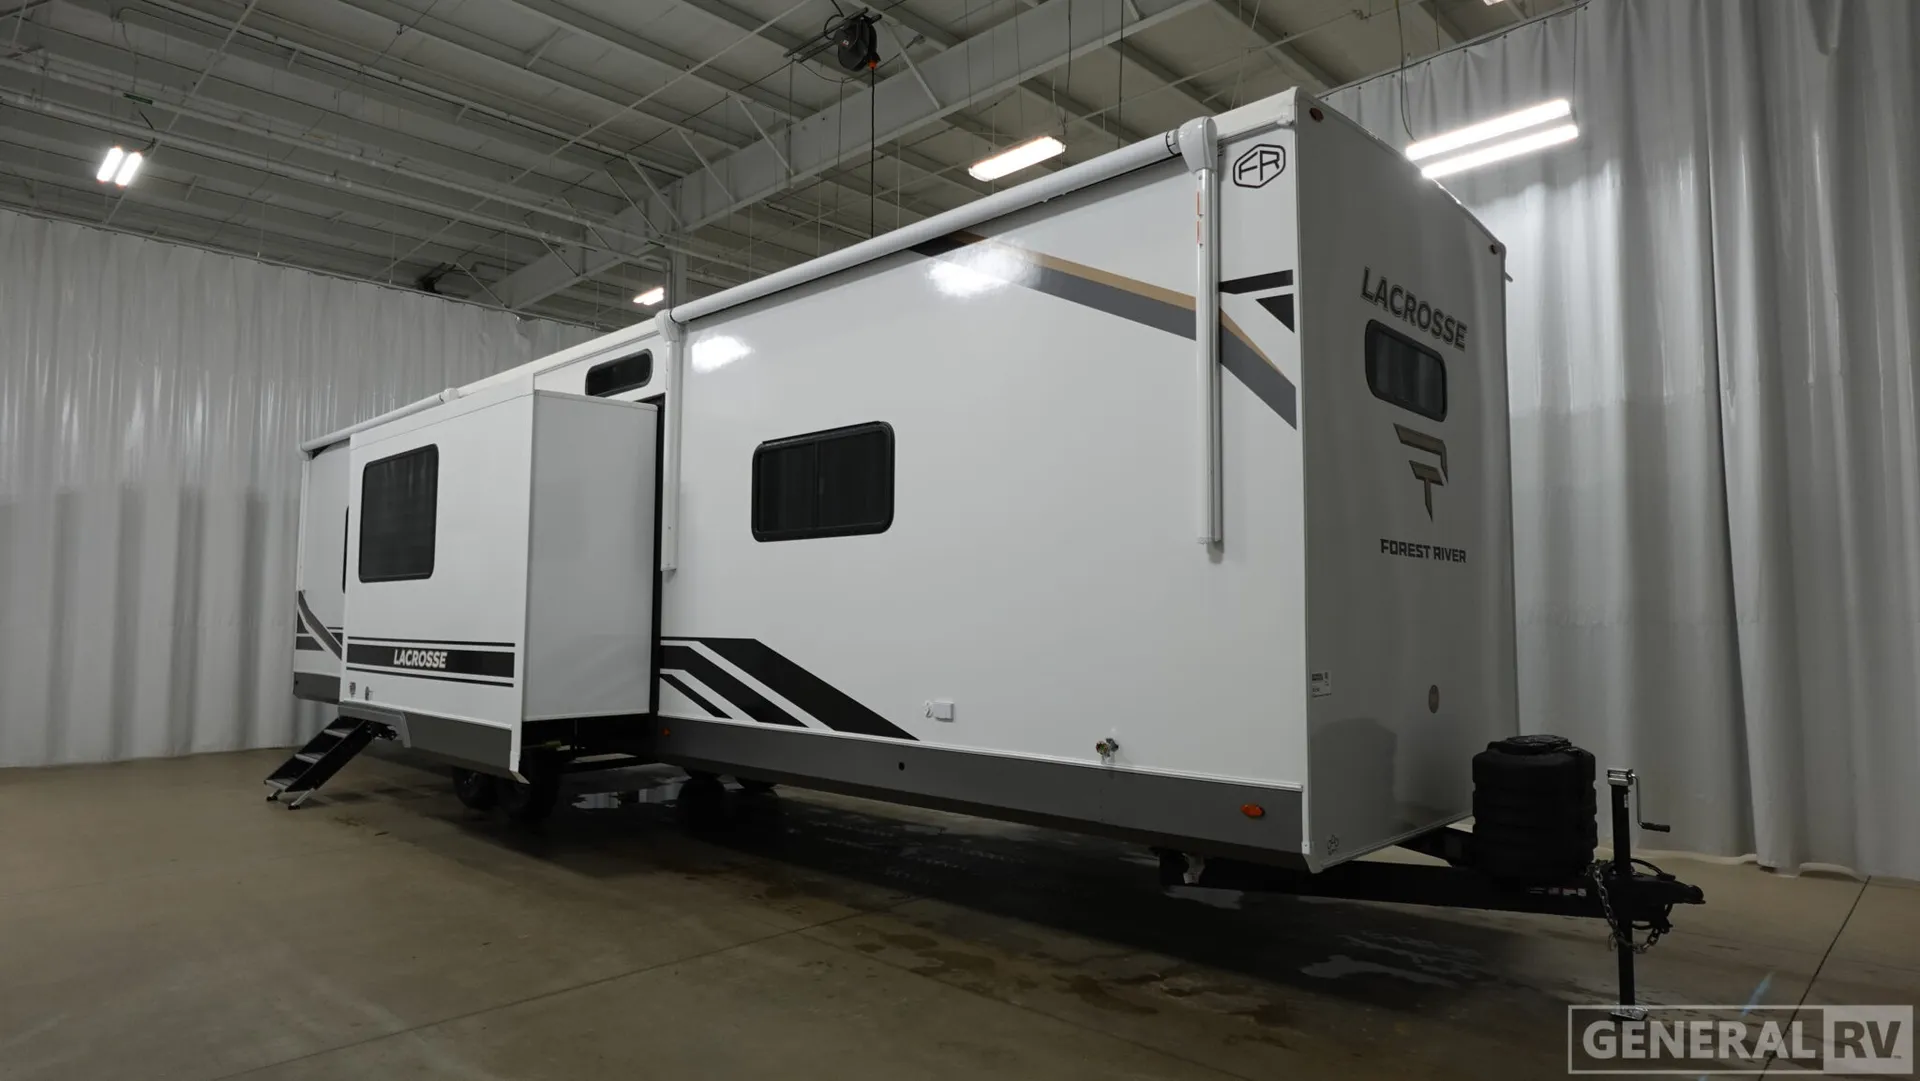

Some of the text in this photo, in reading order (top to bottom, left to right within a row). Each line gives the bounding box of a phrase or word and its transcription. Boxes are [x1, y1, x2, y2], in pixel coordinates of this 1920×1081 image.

[1360, 266, 1468, 352] LACROSSE
[1379, 538, 1467, 563] FOREST RIVER
[393, 649, 448, 669] LACROSSE
